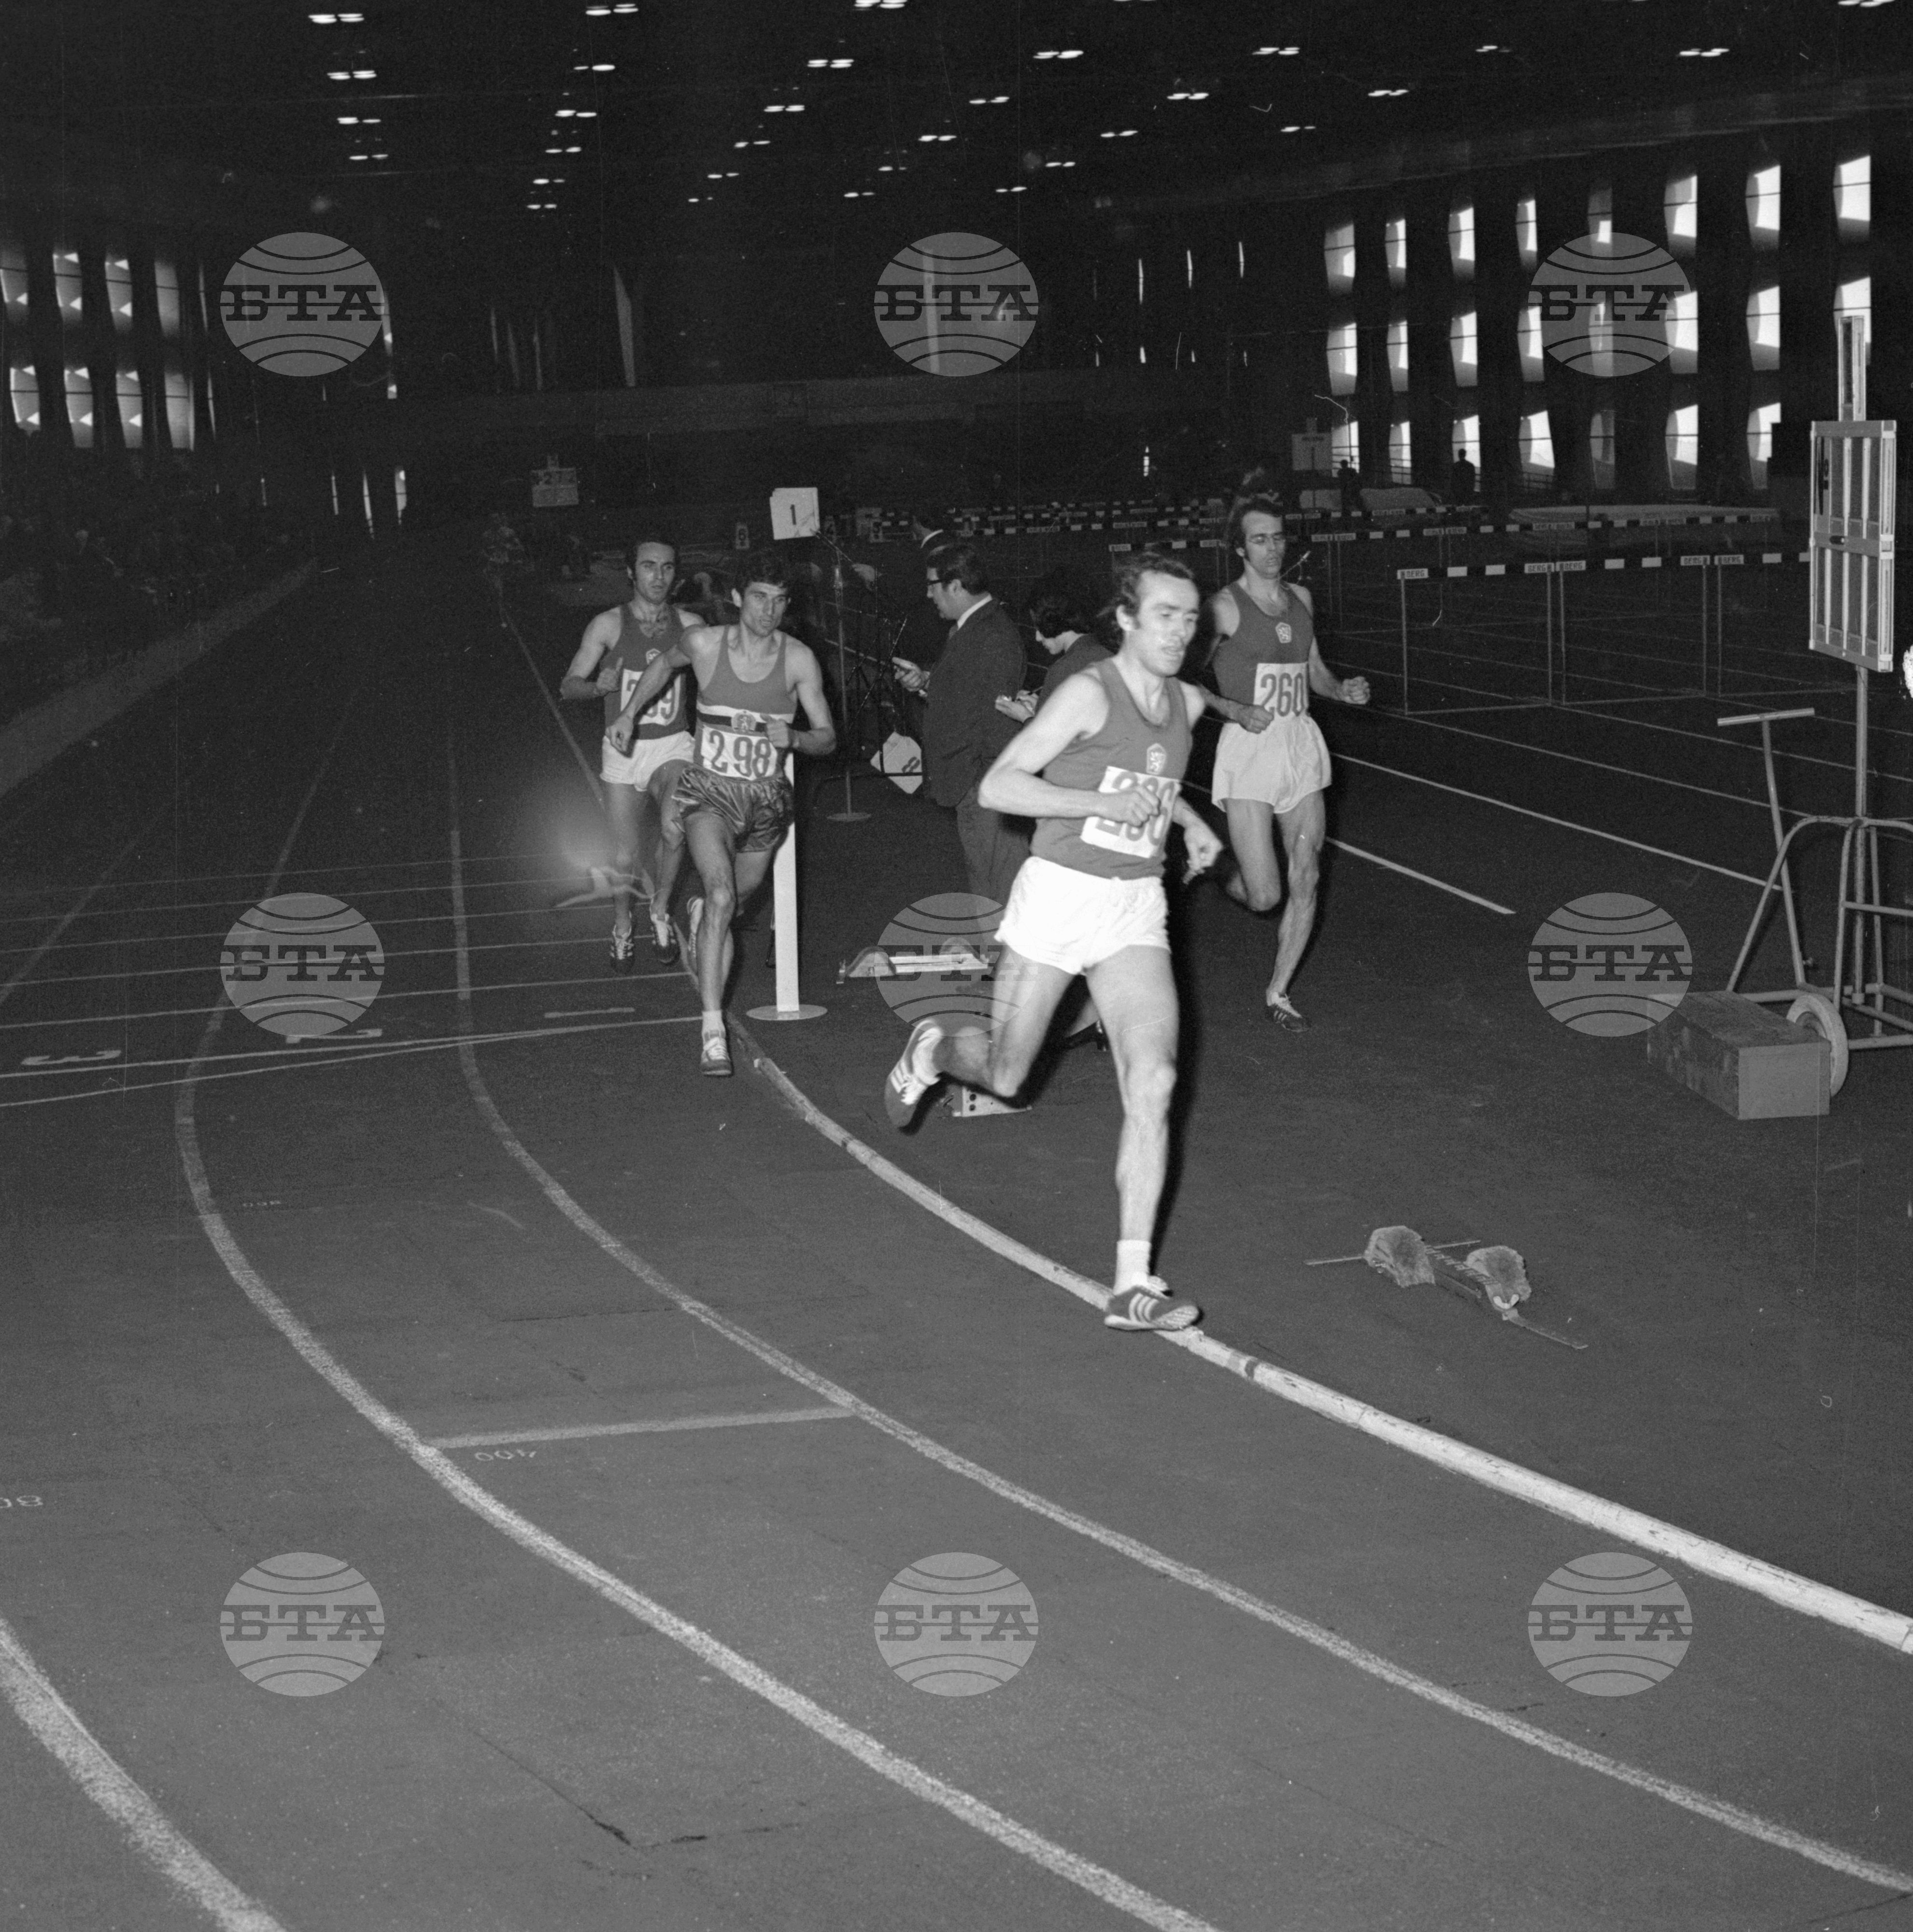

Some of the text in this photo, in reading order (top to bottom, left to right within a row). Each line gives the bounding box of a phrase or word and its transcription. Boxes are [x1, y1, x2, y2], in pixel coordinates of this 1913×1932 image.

[790, 504, 796, 525] 1
[1406, 569, 1425, 578] BERG
[1261, 672, 1304, 717] 260
[709, 730, 771, 777] 298
